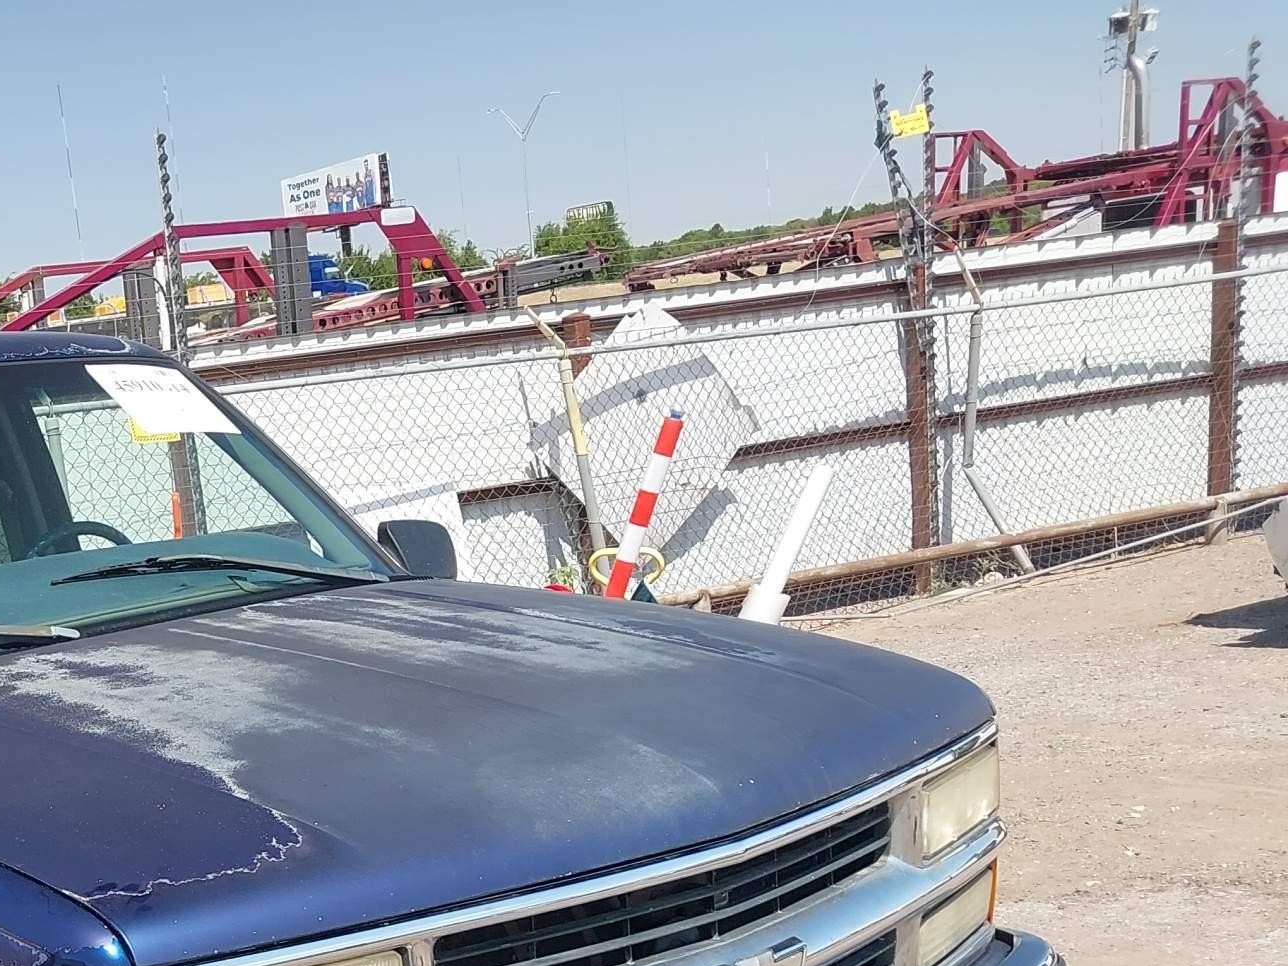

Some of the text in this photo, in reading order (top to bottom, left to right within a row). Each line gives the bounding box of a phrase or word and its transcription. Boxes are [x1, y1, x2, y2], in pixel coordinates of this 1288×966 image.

[287, 177, 320, 190] Together
[289, 188, 321, 203] As One
